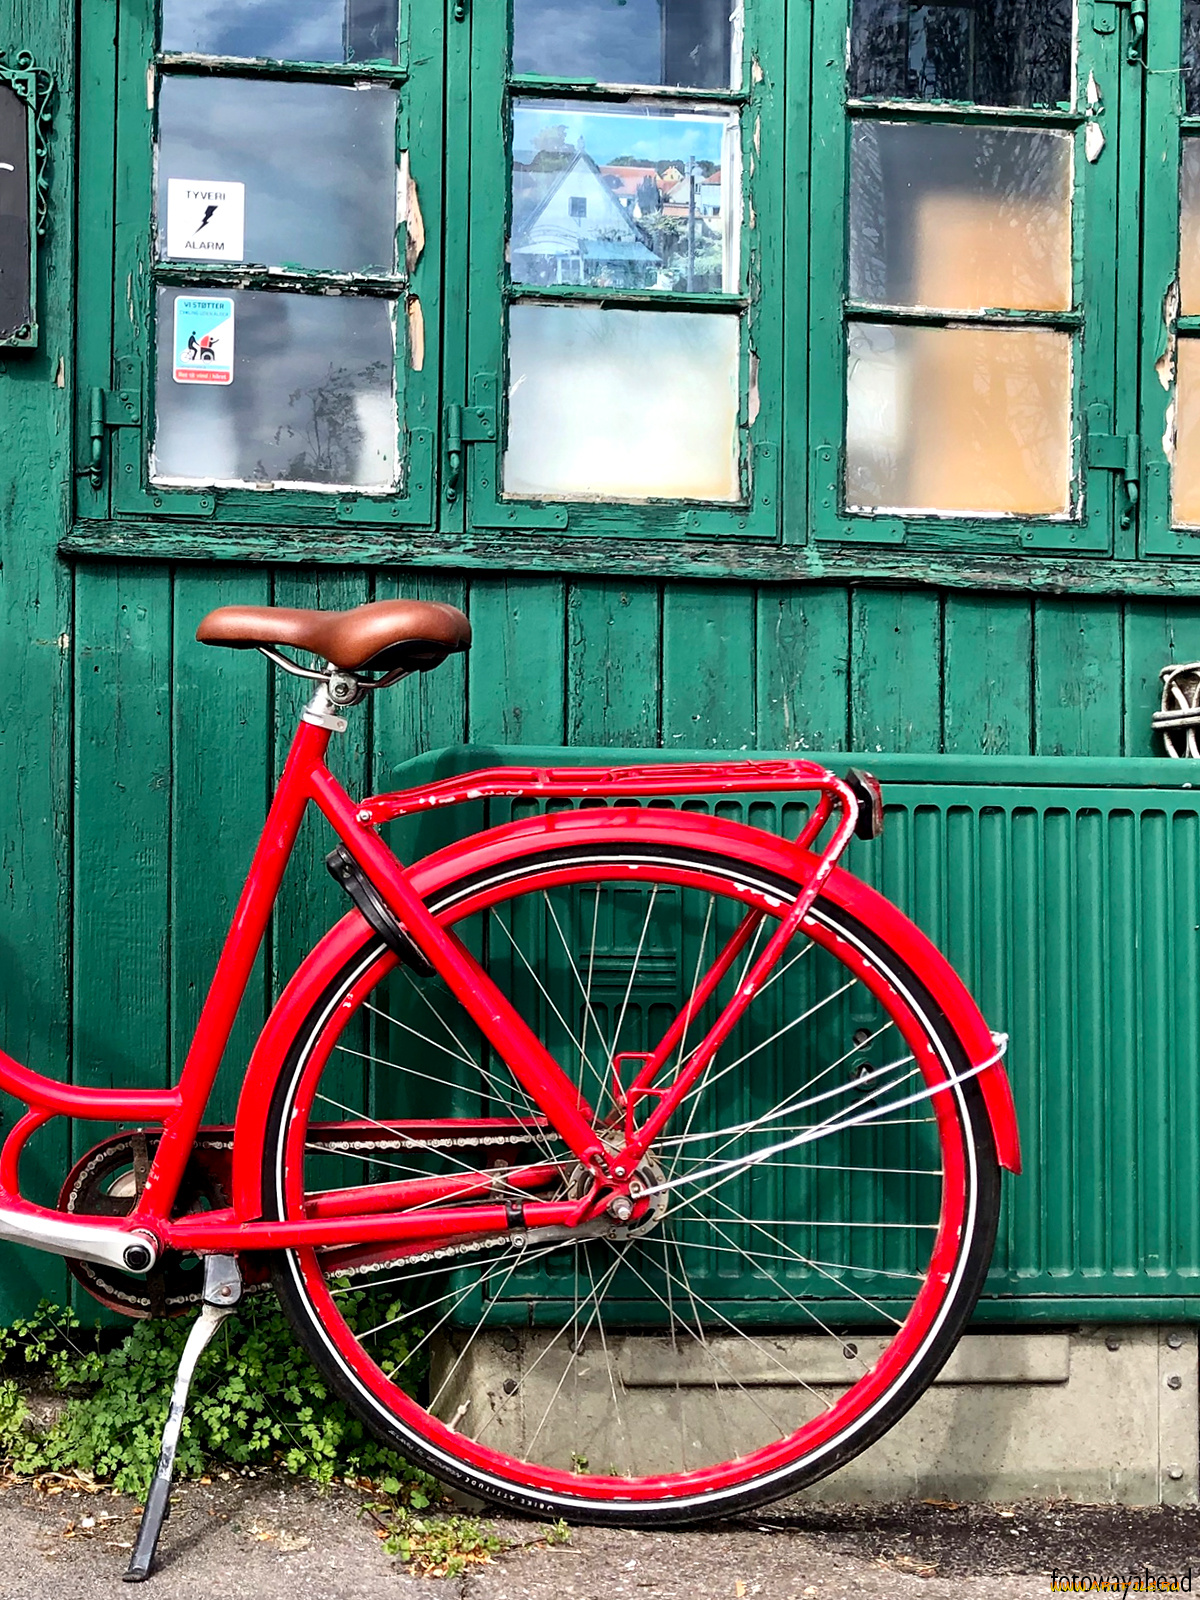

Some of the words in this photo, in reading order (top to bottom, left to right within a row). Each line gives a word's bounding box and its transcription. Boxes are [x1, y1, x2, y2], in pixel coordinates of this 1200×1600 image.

[186, 190, 226, 201] TYVERI
[184, 240, 225, 251] ALARM
[193, 301, 225, 310] STØTTER
